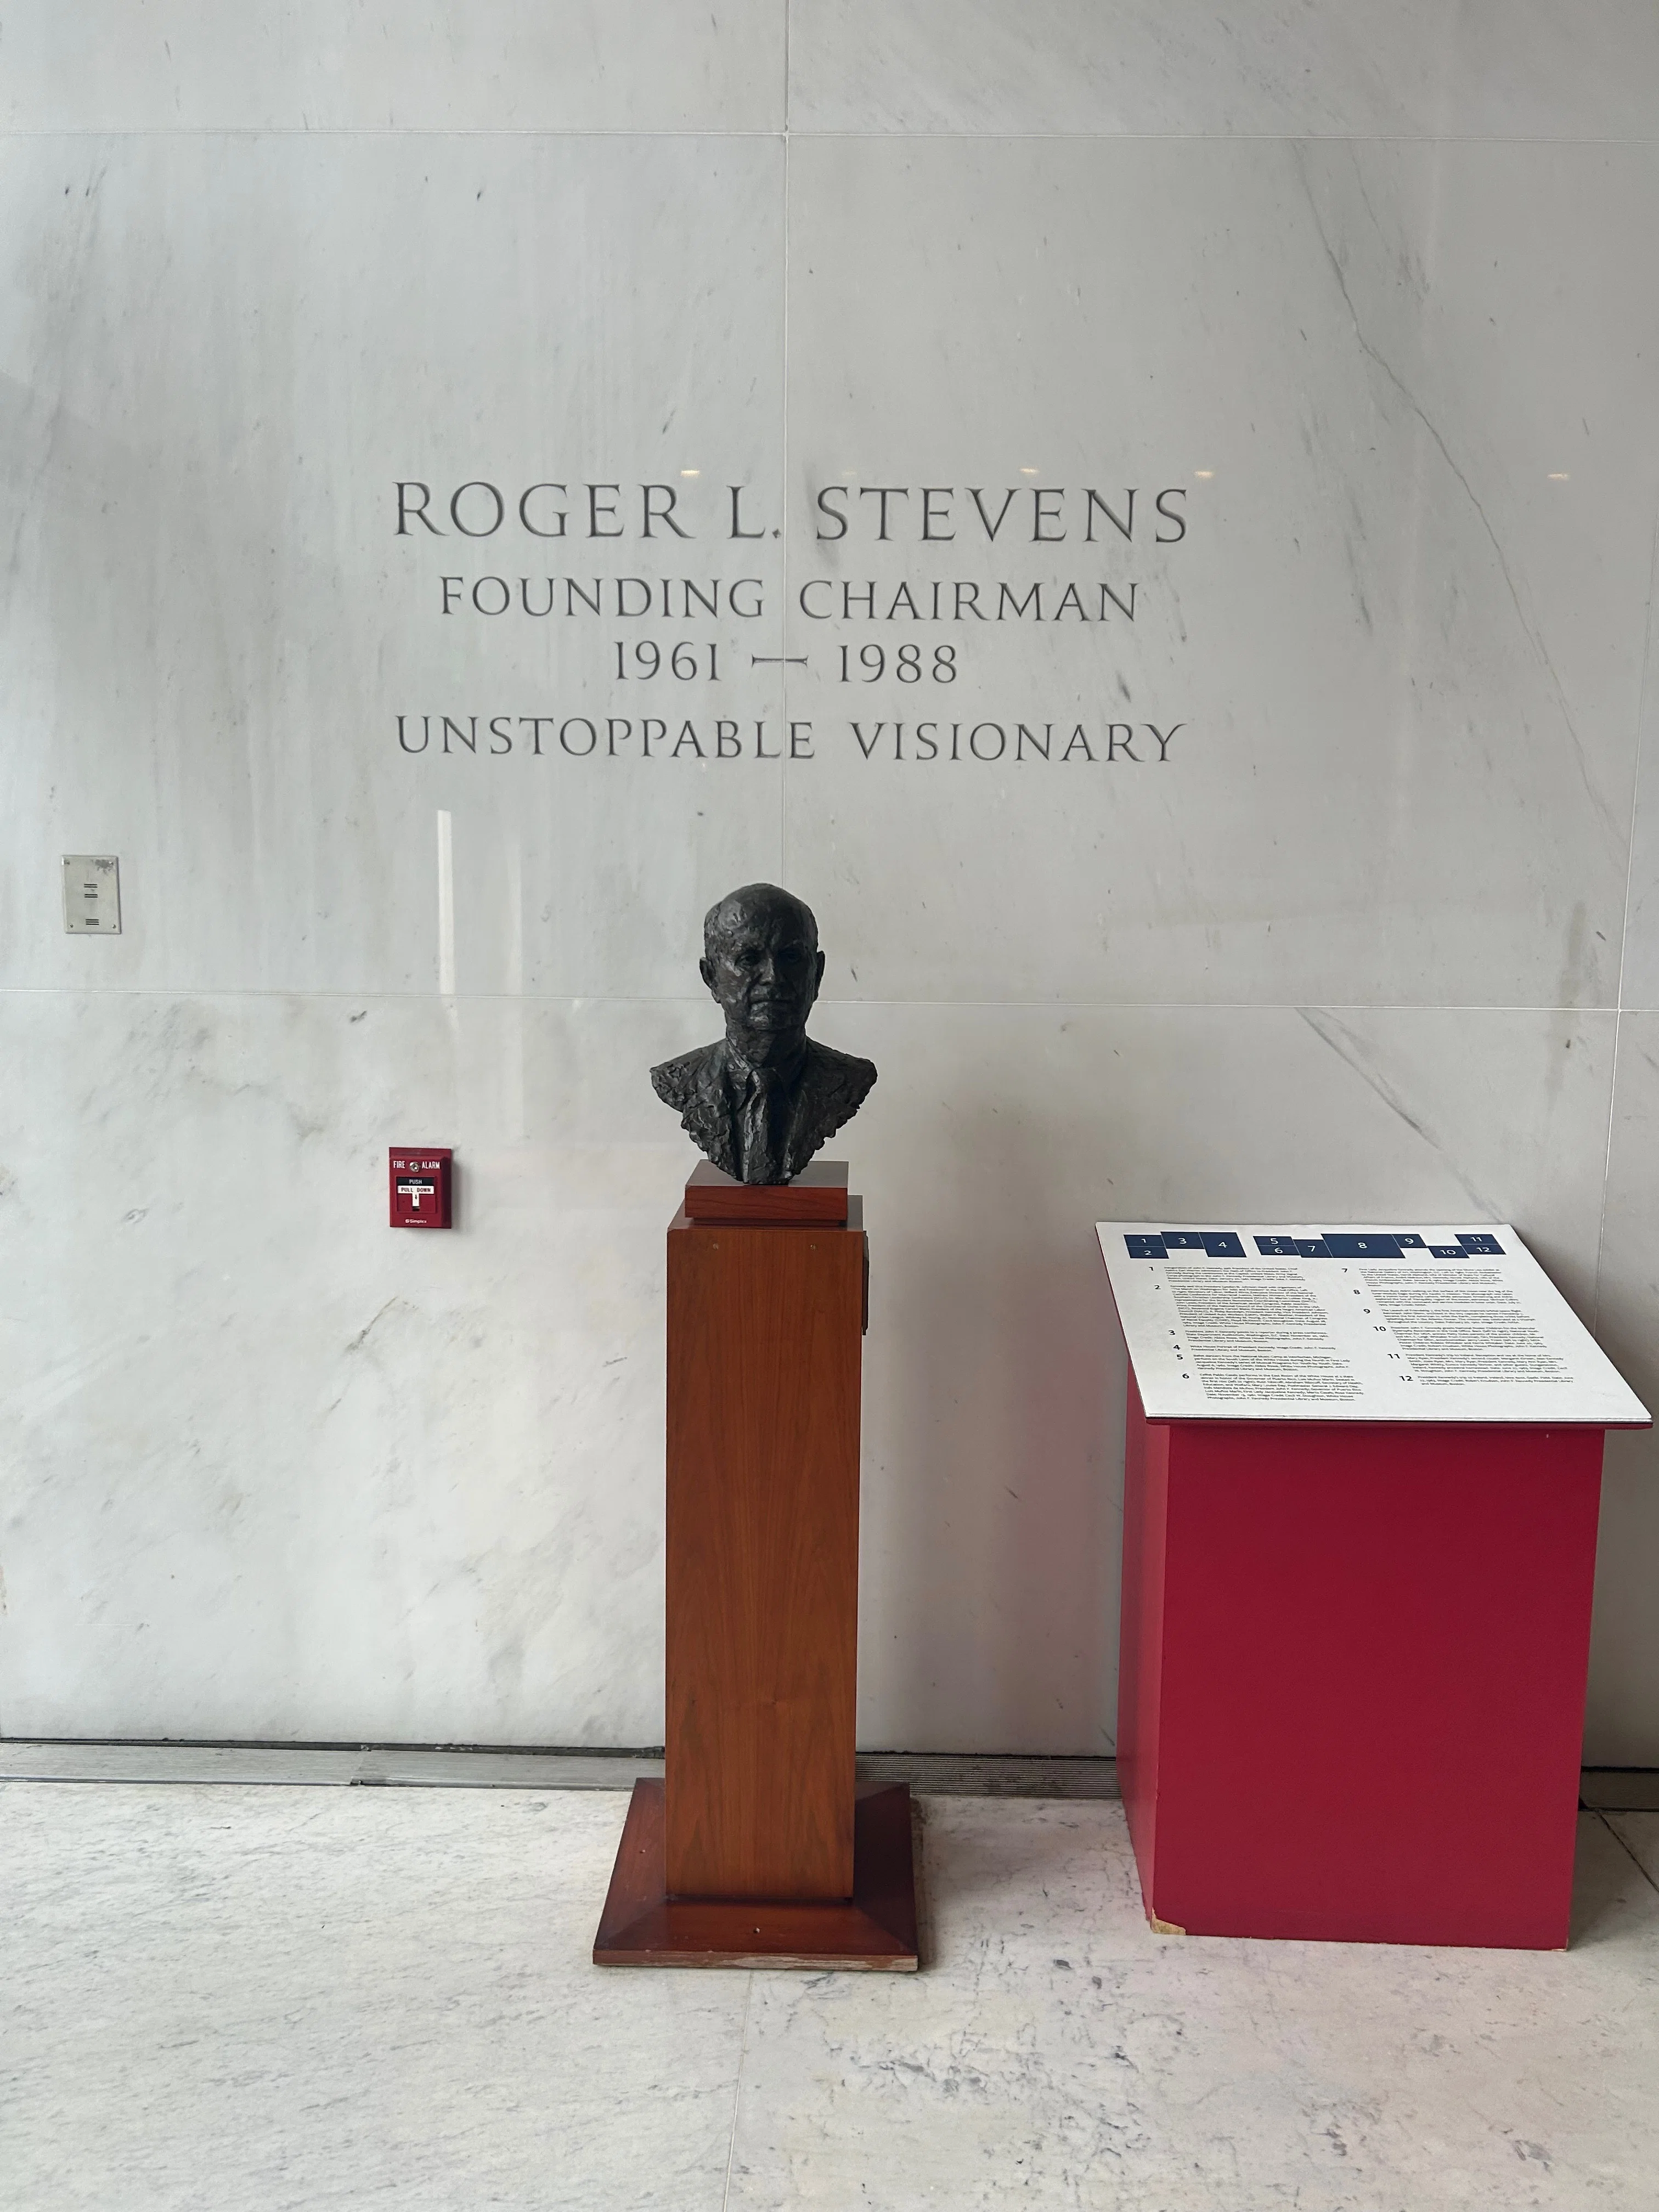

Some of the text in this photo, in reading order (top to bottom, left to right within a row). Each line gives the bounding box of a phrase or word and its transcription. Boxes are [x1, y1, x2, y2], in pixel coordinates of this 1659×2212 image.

[392, 481, 1187, 543] ROGER L. STEVENS
[439, 576, 1138, 622] FOUNDING CHAIRMAN
[614, 640, 720, 681] 1961
[839, 644, 957, 684] 1988
[396, 715, 1186, 763] UNSTOPPABLE VISIONARY
[393, 1160, 440, 1169] FIRE ALARM
